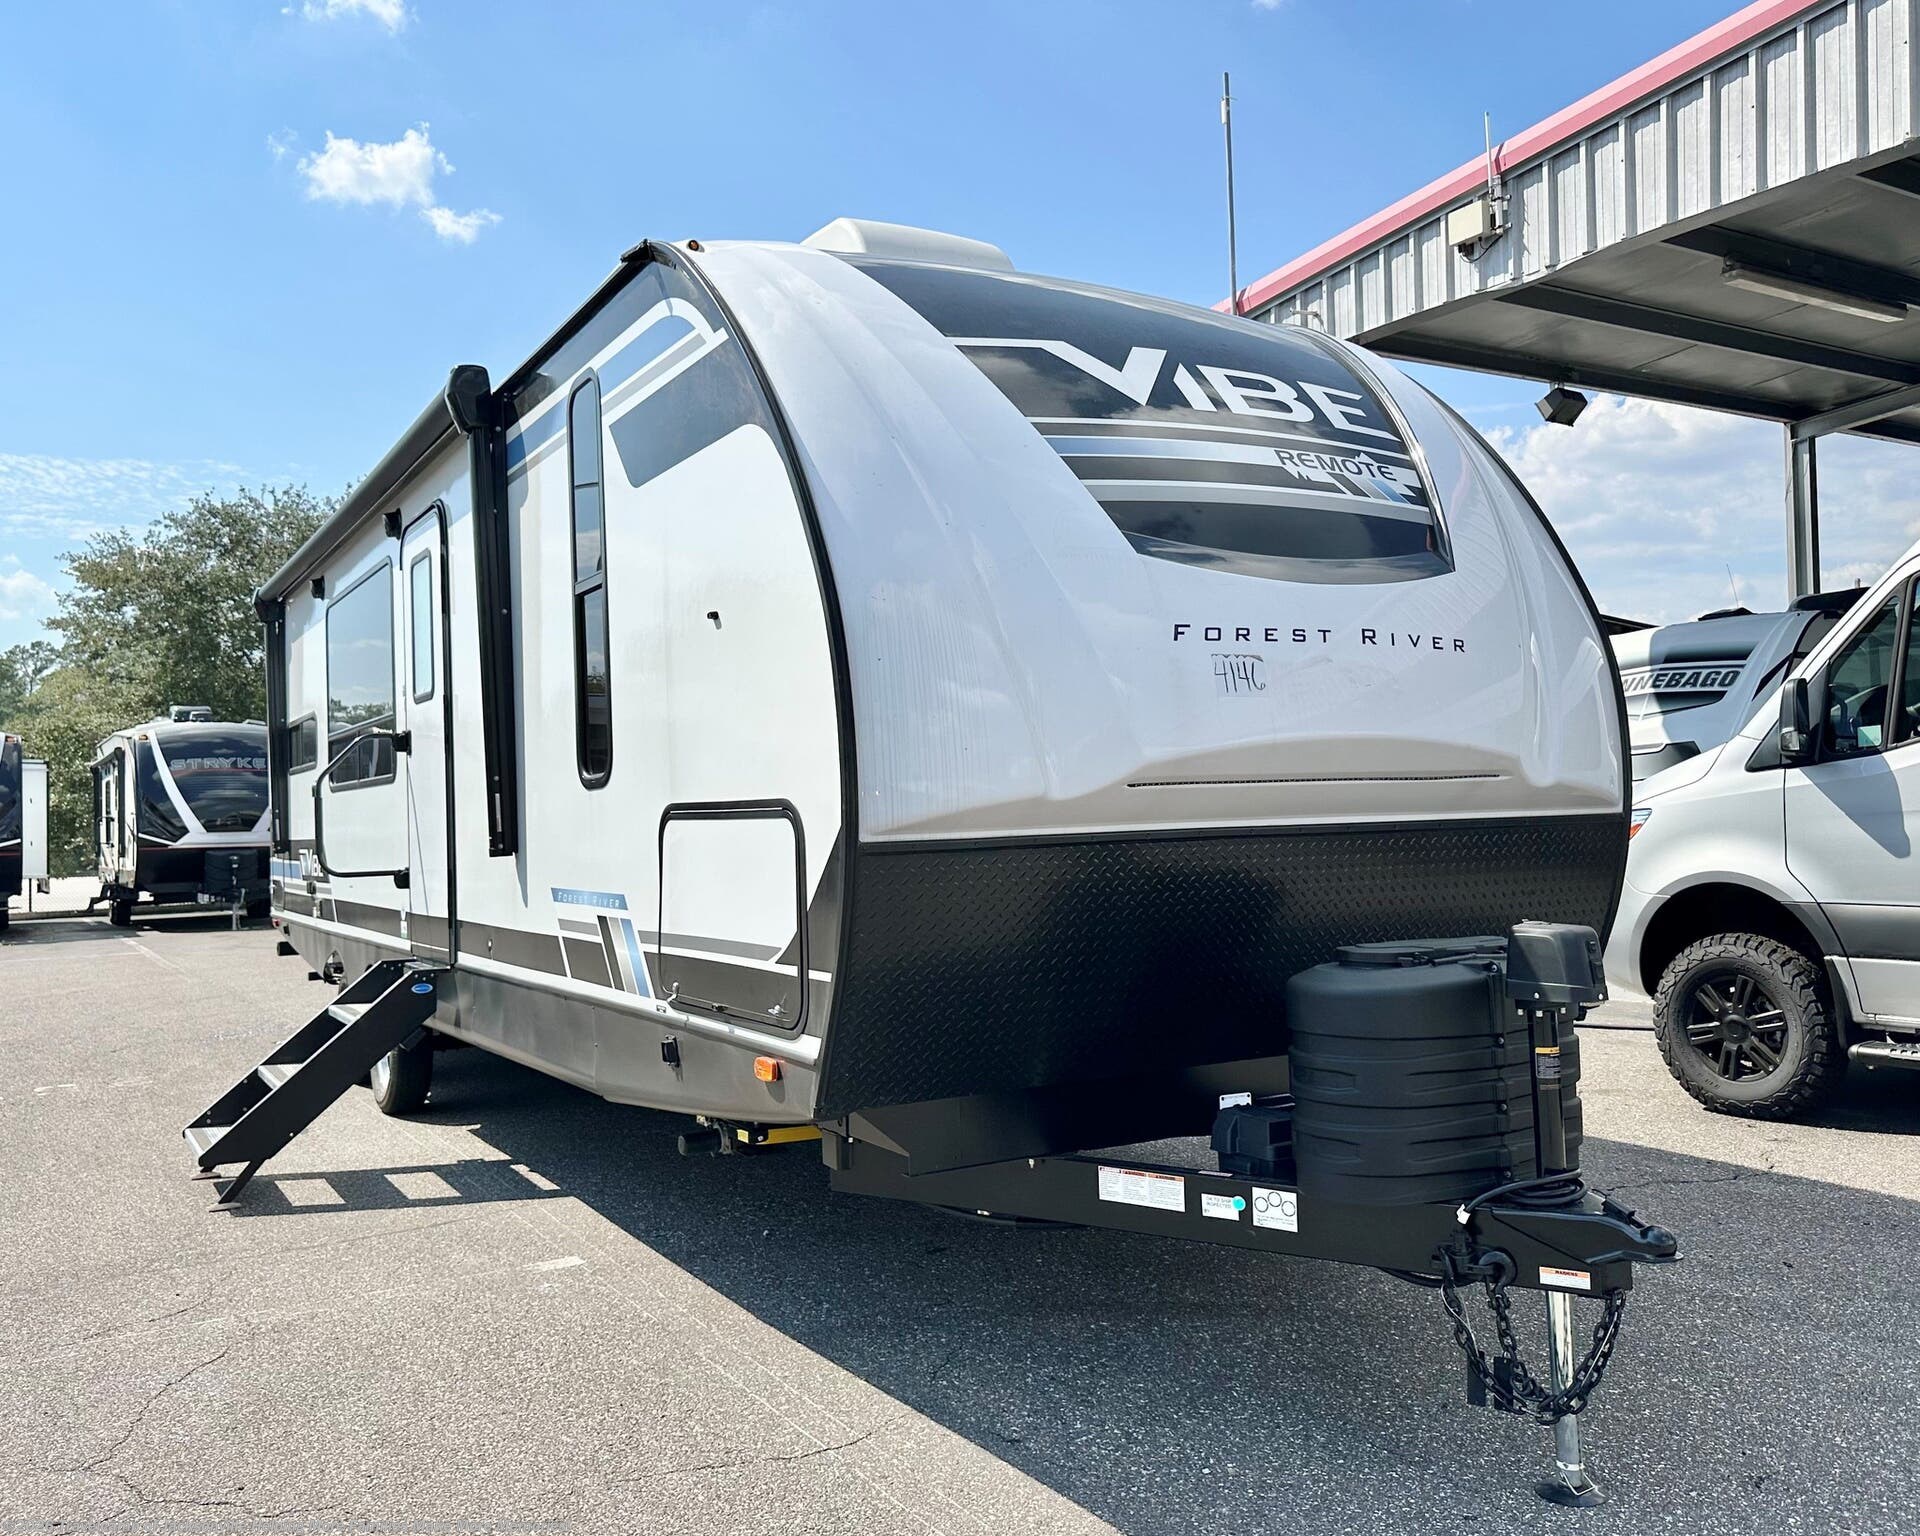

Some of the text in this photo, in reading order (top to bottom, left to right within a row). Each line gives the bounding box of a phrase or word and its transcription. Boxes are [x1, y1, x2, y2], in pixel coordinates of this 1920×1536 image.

[955, 337, 1401, 441] VIBE
[1274, 449, 1398, 482] REMOTE
[1173, 623, 1466, 653] FOREST RIVER
